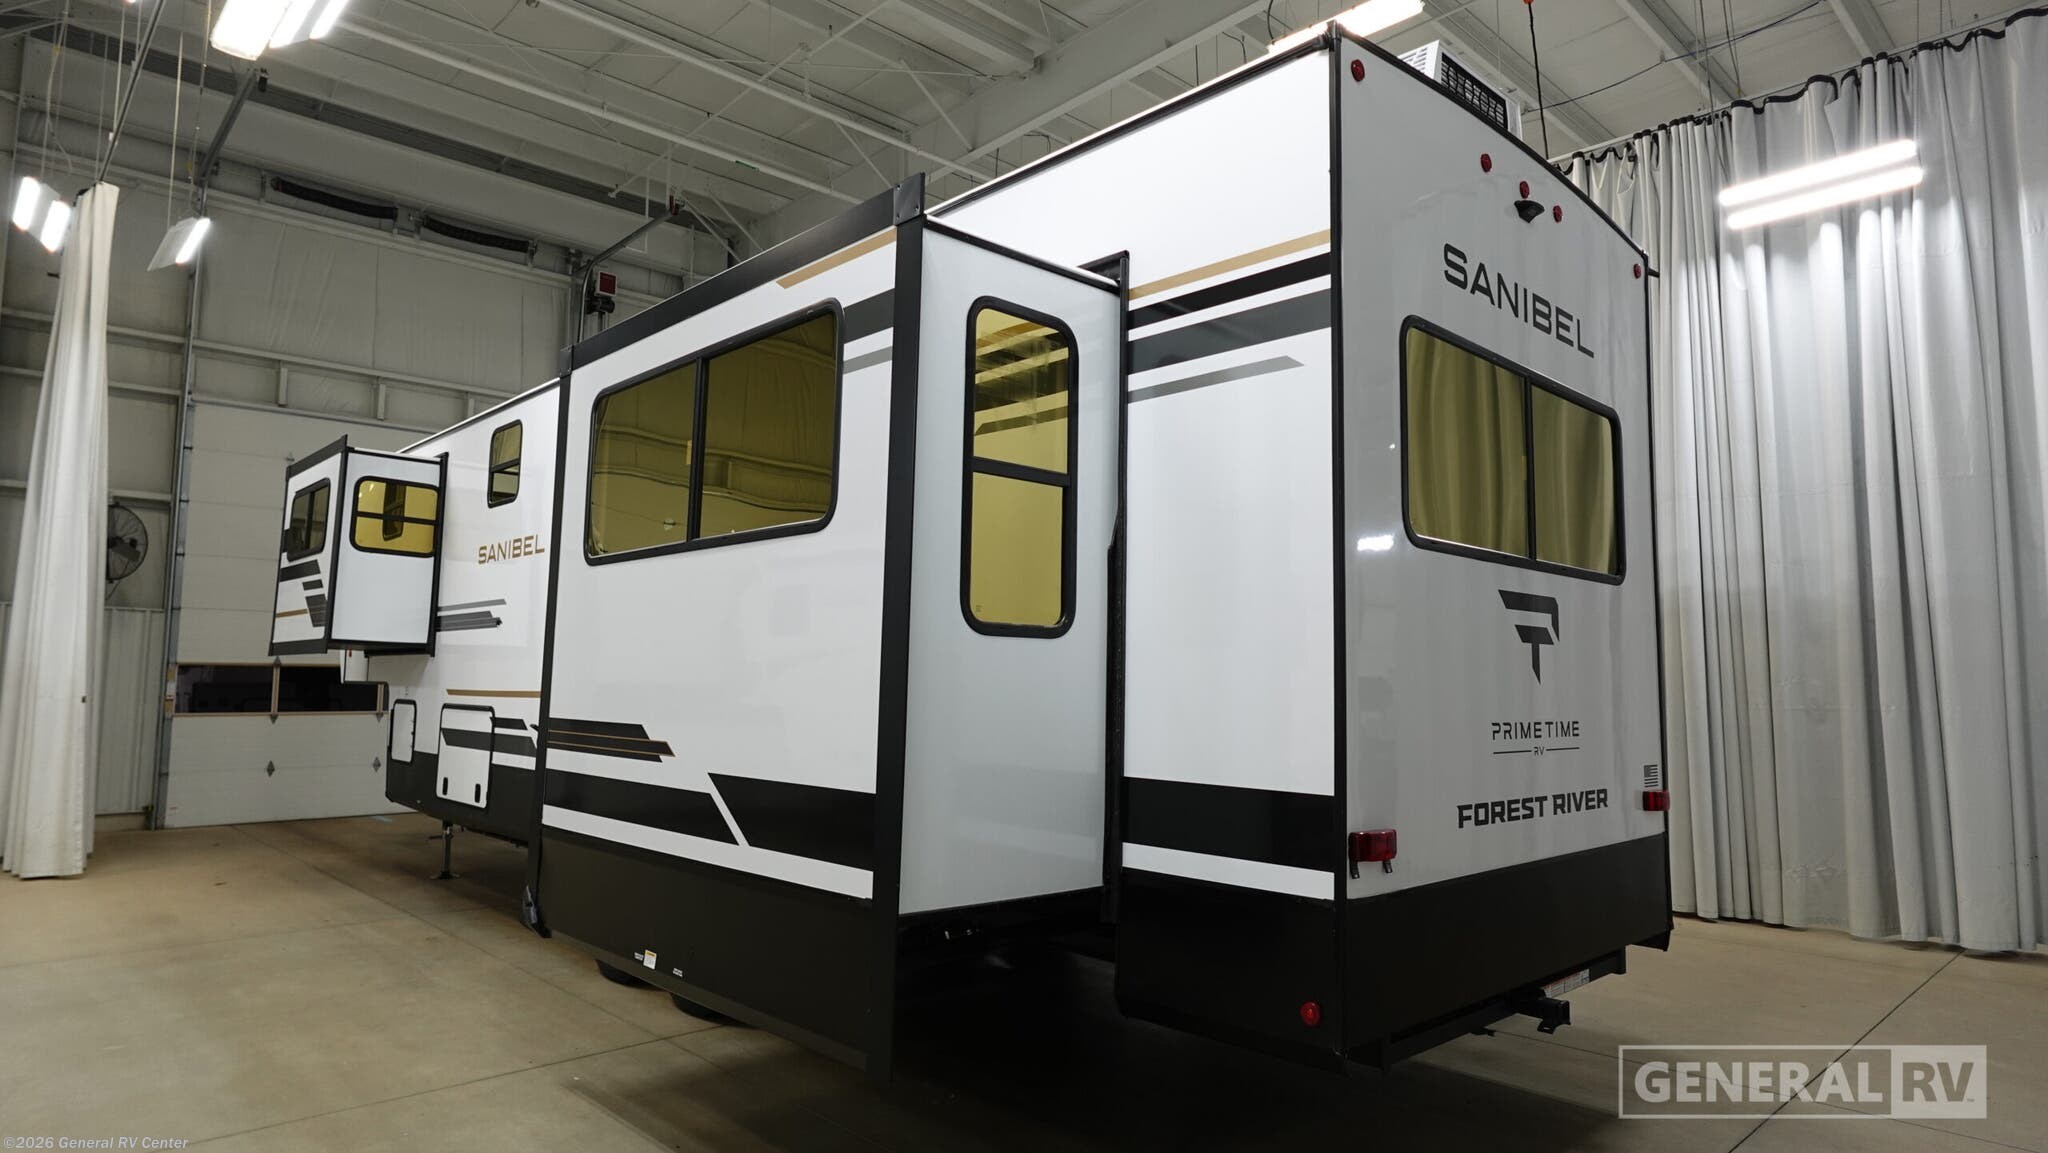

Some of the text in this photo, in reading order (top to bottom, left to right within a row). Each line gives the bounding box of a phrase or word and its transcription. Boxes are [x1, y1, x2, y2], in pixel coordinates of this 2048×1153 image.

[1443, 242, 1595, 359] SANIBEL
[478, 533, 545, 565] SANIBEL
[1533, 746, 1545, 756] RV
[1457, 788, 1609, 829] FOREST RIVER
